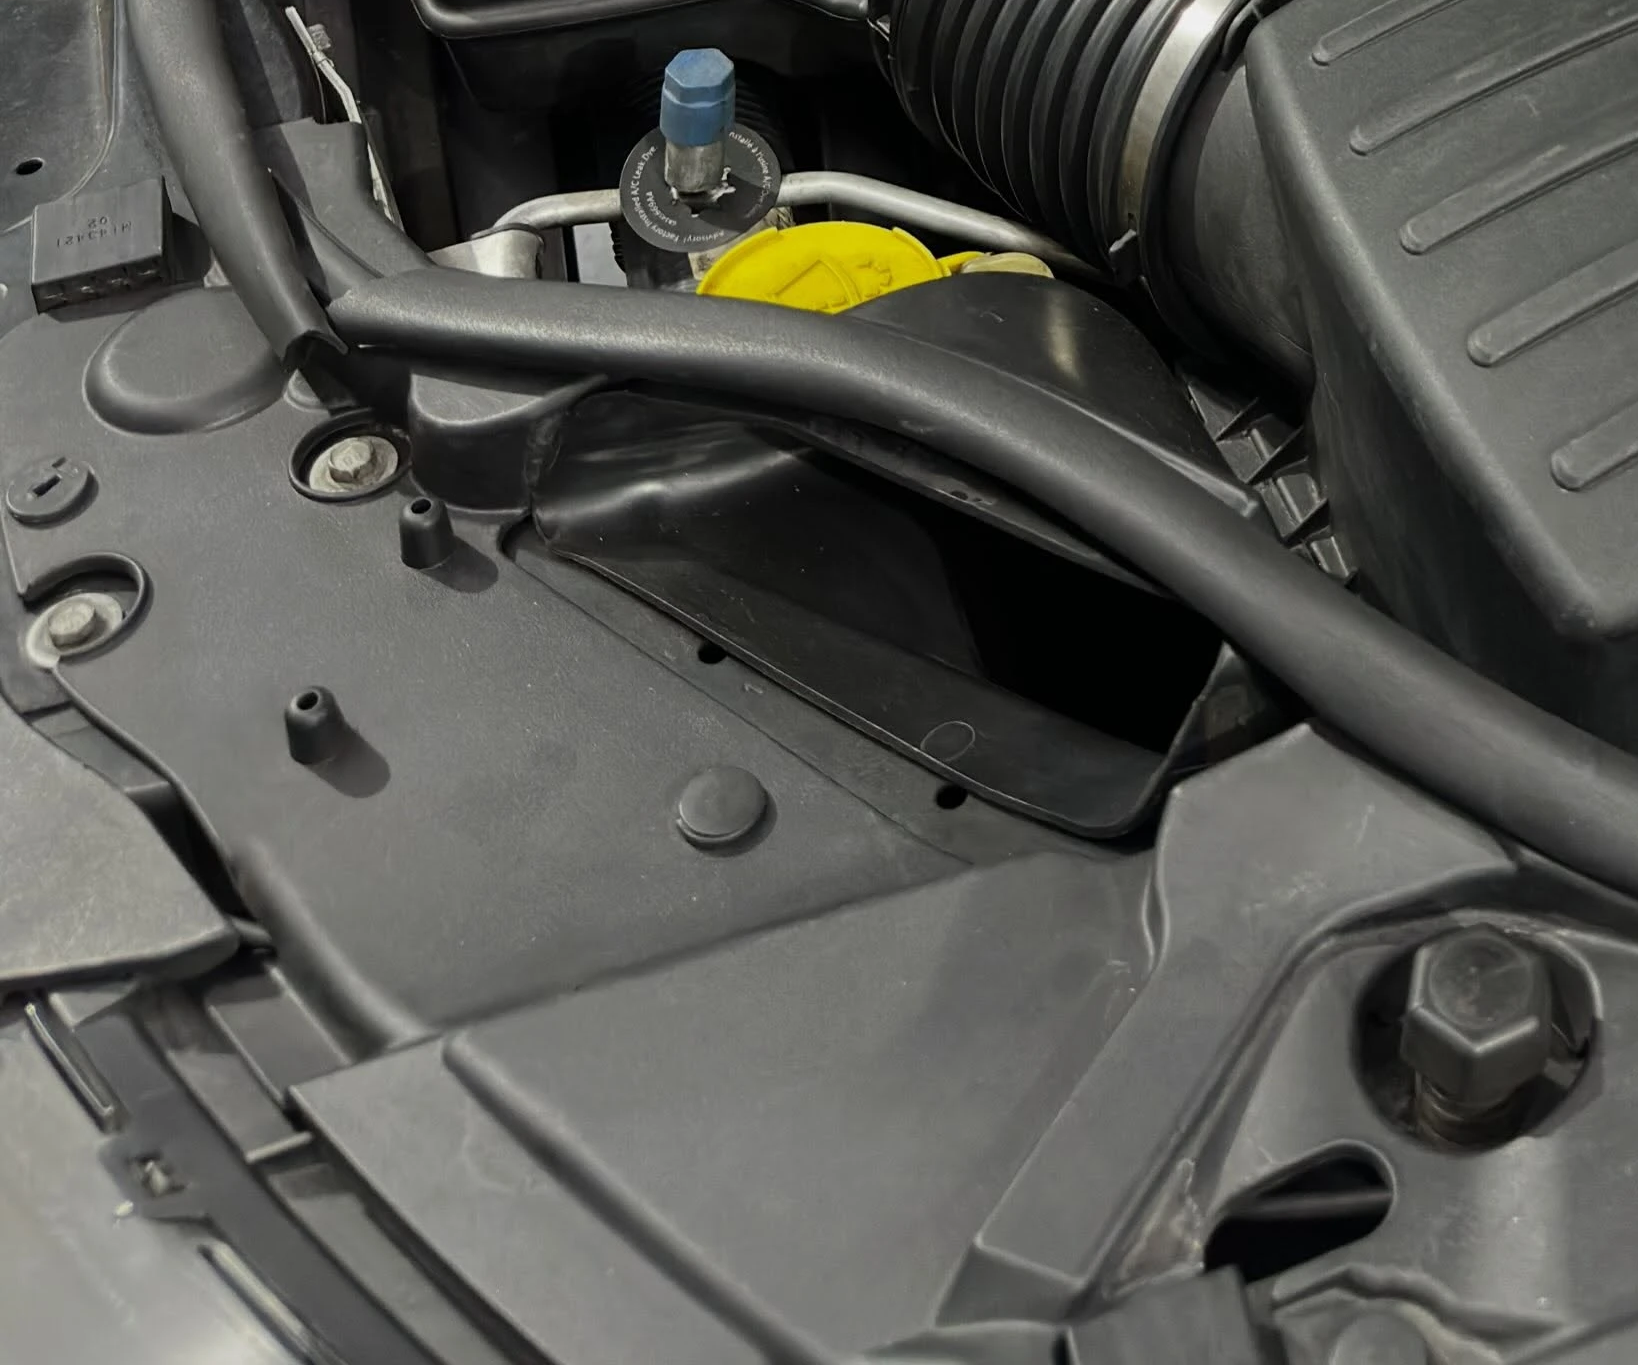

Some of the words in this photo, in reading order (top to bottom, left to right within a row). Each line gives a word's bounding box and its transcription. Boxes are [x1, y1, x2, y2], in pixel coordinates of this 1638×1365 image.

[633, 161, 645, 179] Leak
[631, 197, 652, 227] Installed
[652, 225, 680, 244] Factory
